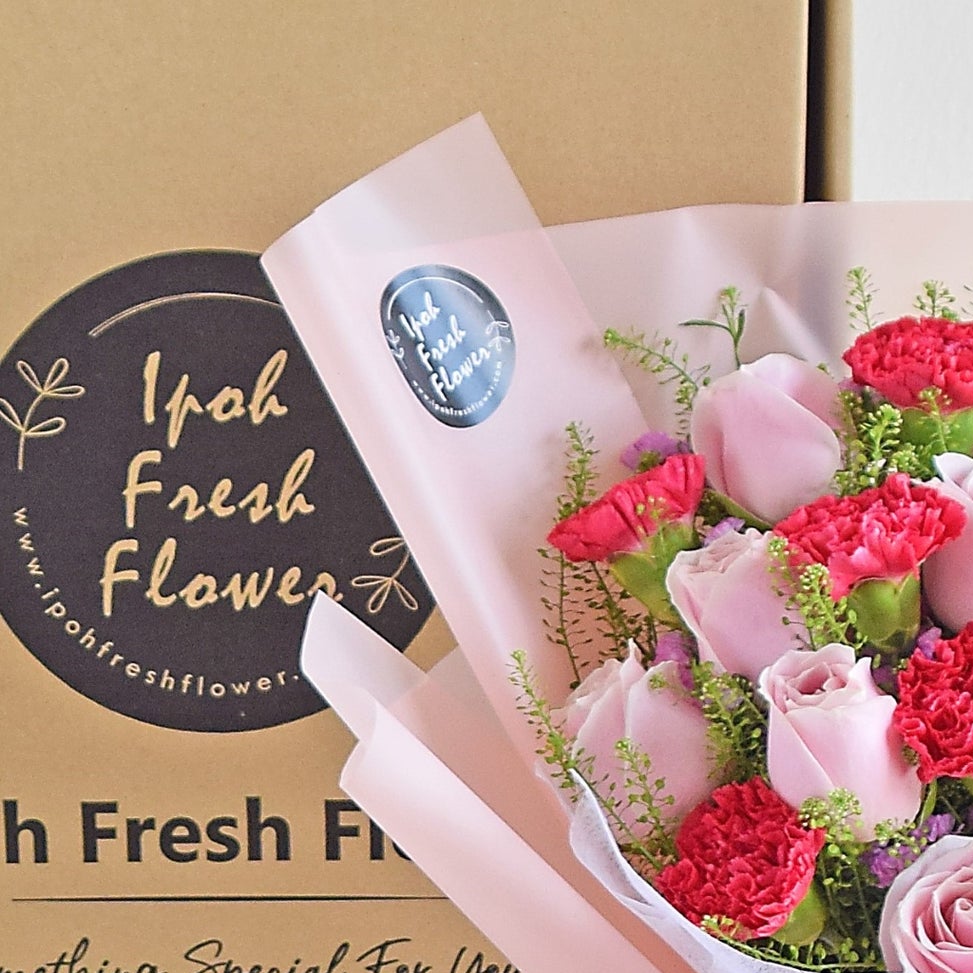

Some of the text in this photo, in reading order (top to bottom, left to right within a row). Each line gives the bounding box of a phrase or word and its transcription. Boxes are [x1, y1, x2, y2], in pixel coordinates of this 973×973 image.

[400, 291, 441, 342] Ipoh
[416, 314, 467, 372] Fresh
[142, 349, 289, 449] Ipoh
[429, 346, 492, 402] Flower
[122, 448, 315, 529] Fresh
[99, 537, 344, 617] Flower
[80, 796, 291, 863] Fresh
[324, 798, 412, 861] Fl
